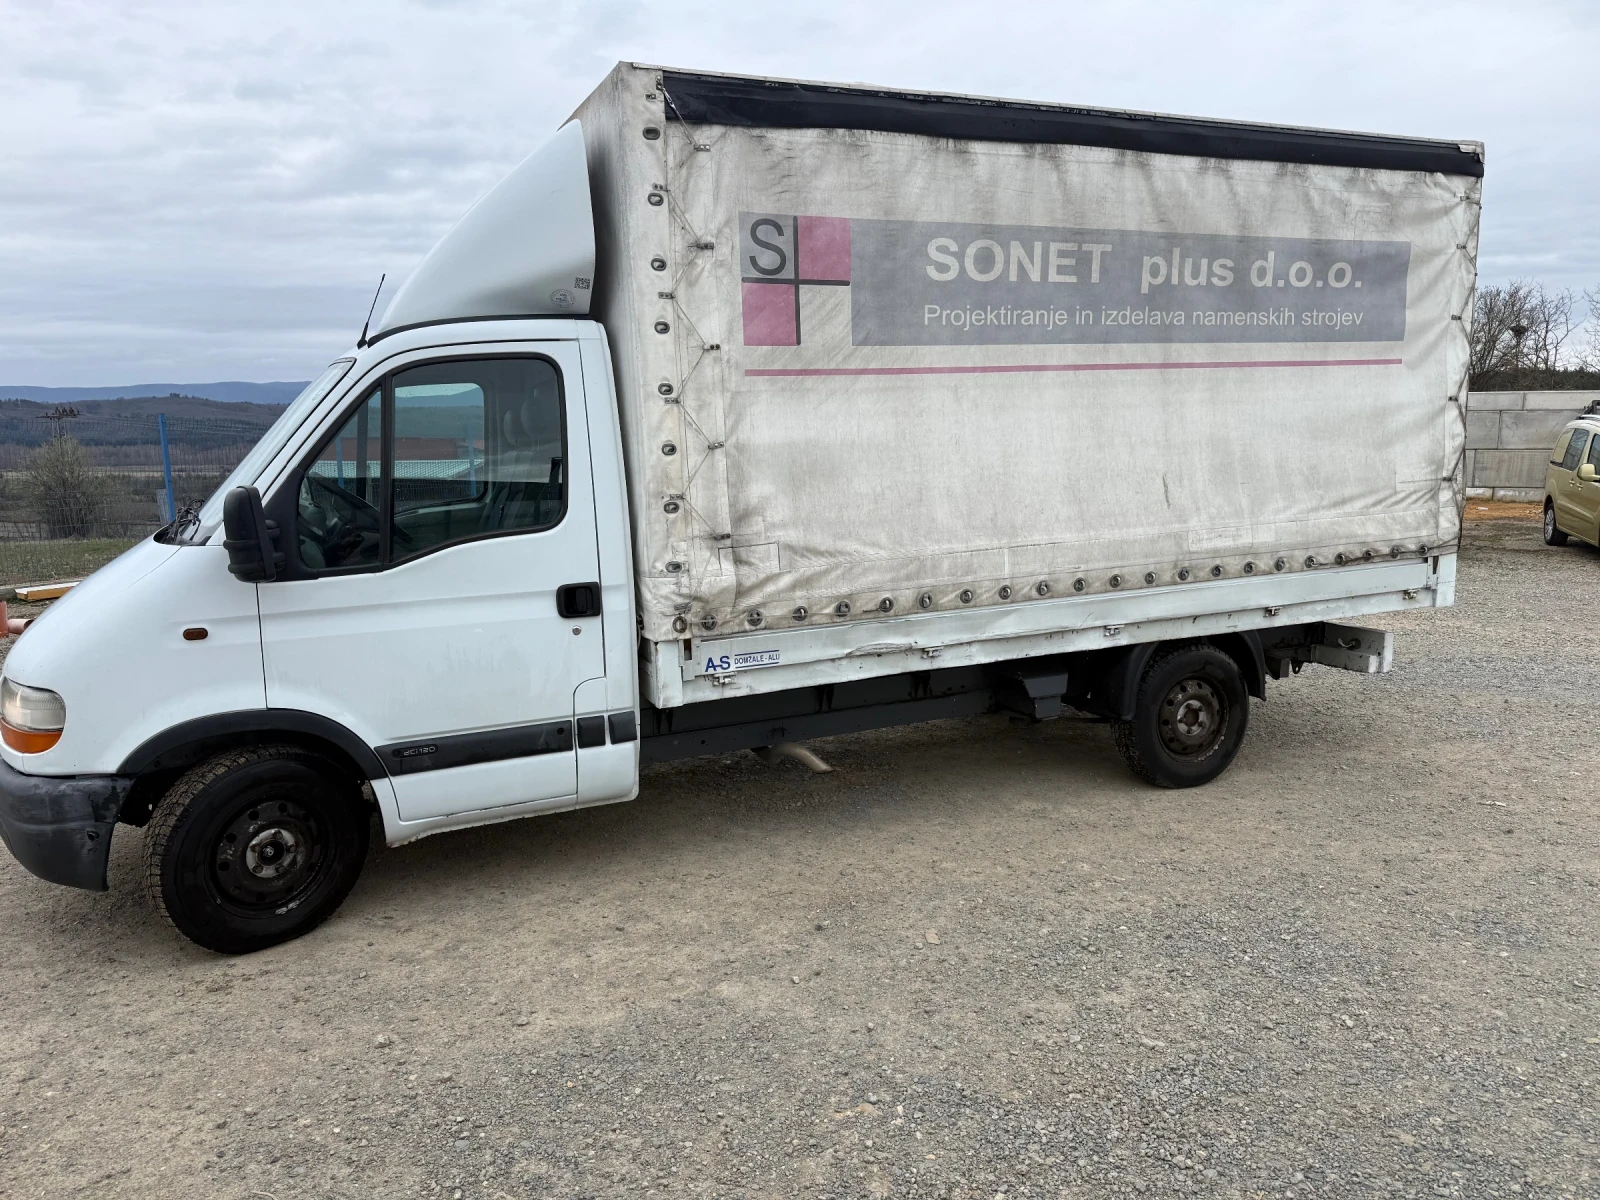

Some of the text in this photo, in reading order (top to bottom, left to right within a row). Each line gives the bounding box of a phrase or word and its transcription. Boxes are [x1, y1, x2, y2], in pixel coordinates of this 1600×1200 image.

[925, 237, 1363, 294] SONET plus d.o.o.
[923, 304, 1364, 331] Projektiranje in izdelava namenskih strojev
